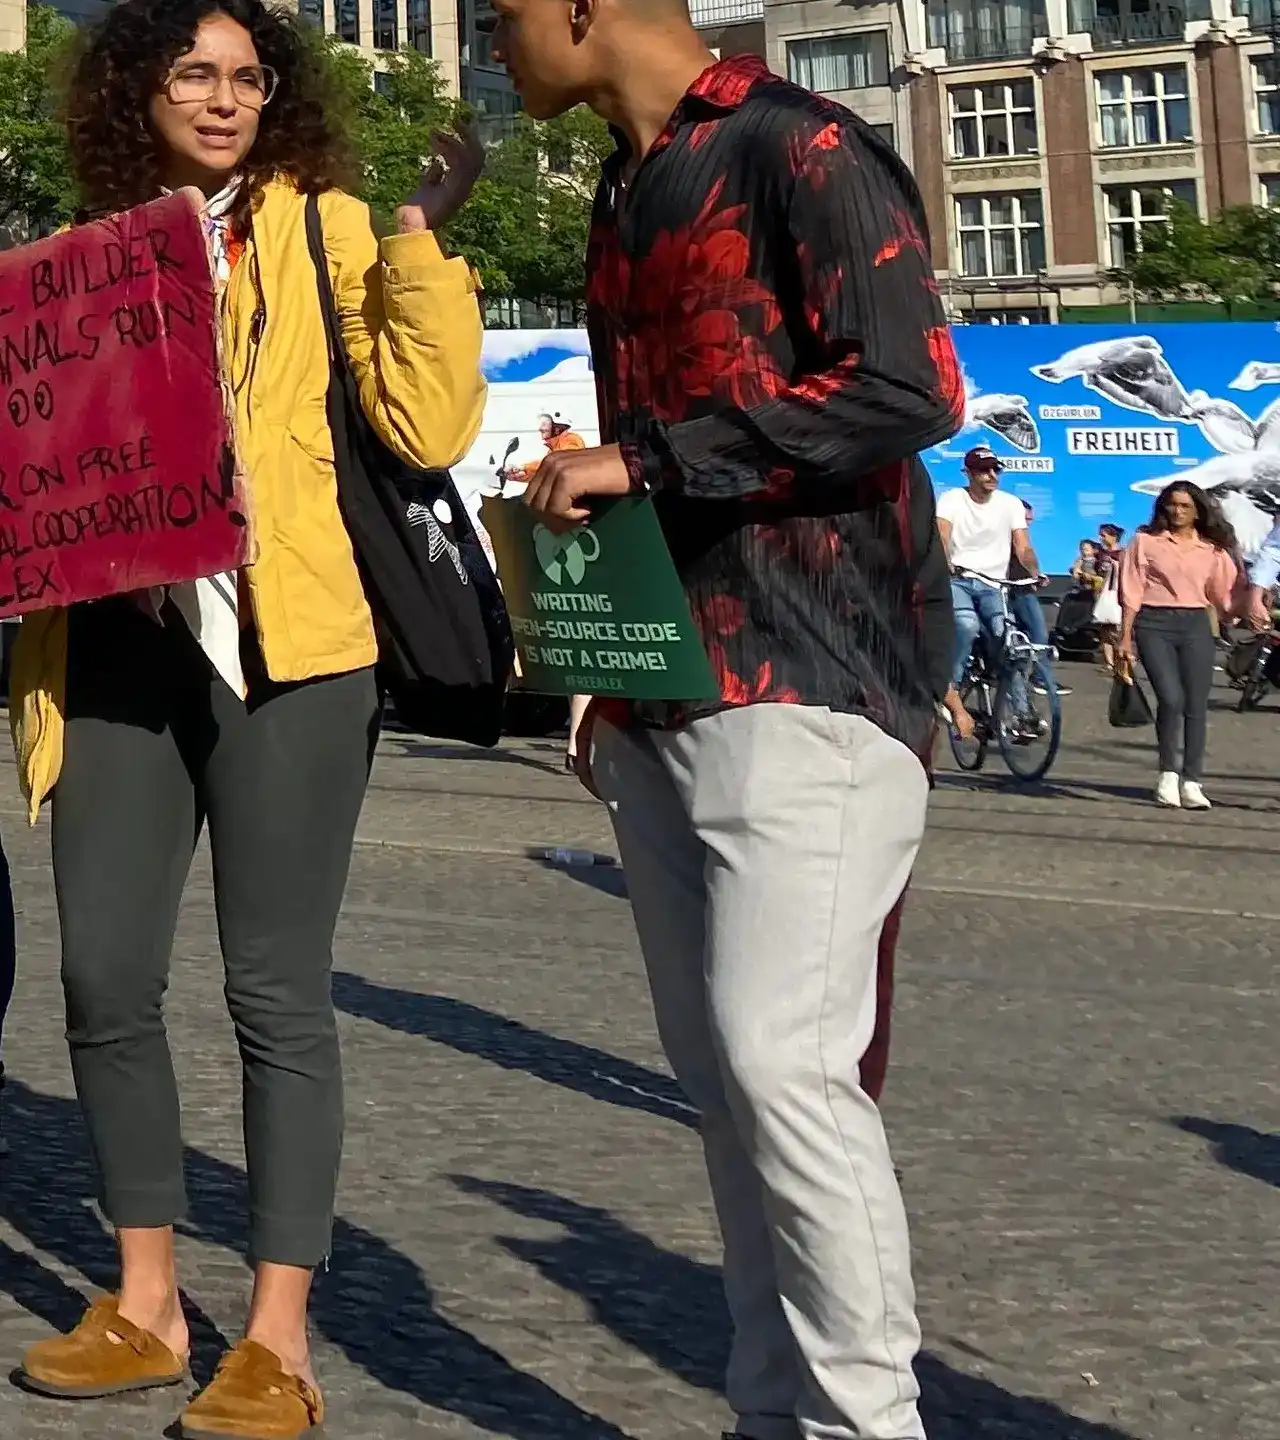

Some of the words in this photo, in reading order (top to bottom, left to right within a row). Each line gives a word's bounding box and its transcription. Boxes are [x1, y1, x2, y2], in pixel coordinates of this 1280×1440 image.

[30, 228, 187, 311] BUILDER
[108, 293, 197, 348] RUN
[1072, 431, 1176, 452] FREIHEIT
[19, 456, 65, 497] ON
[77, 434, 158, 488] FREE
[530, 592, 613, 613] WRITING
[623, 622, 682, 642] CODE
[524, 644, 540, 663] IS
[540, 646, 573, 668] NOT
[580, 650, 594, 669] A
[595, 650, 669, 671] CRIME!
